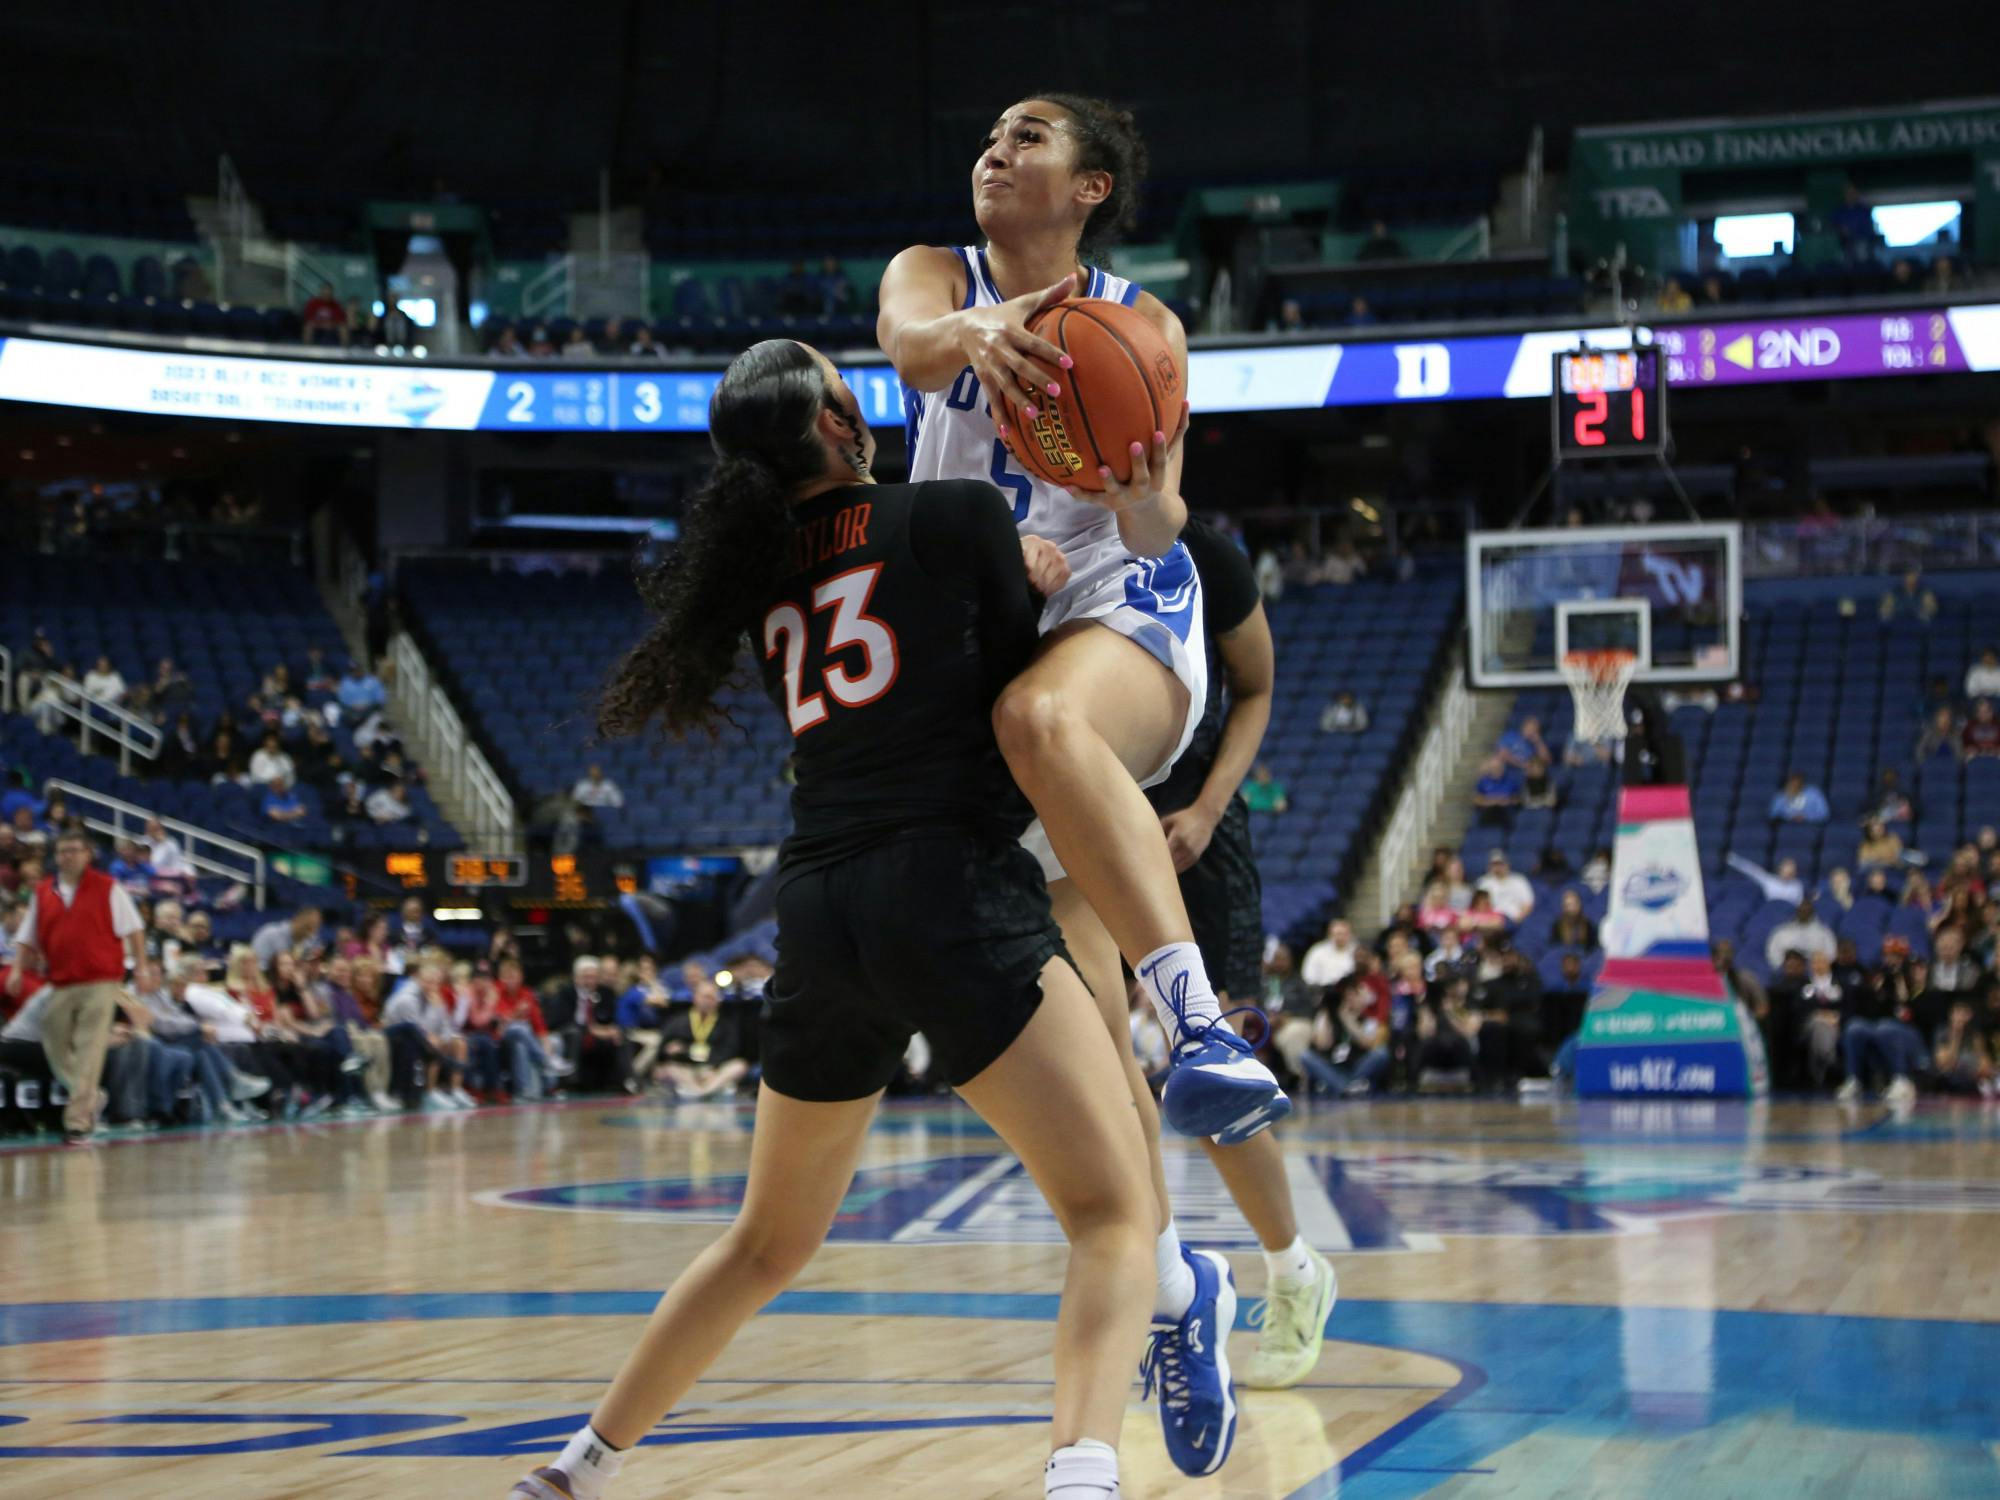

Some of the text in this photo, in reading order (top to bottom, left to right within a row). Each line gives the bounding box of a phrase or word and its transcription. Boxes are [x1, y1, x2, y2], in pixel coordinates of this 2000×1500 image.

[1609, 141, 1705, 170] TRIAD
[1714, 125, 1880, 163] FINANCIAL
[1757, 327, 1841, 369] 2ND
[506, 380, 536, 423] 2
[633, 380, 663, 423] 3
[1574, 386, 1645, 446] 21
[990, 437, 1033, 524] 5
[763, 560, 900, 738] 23
